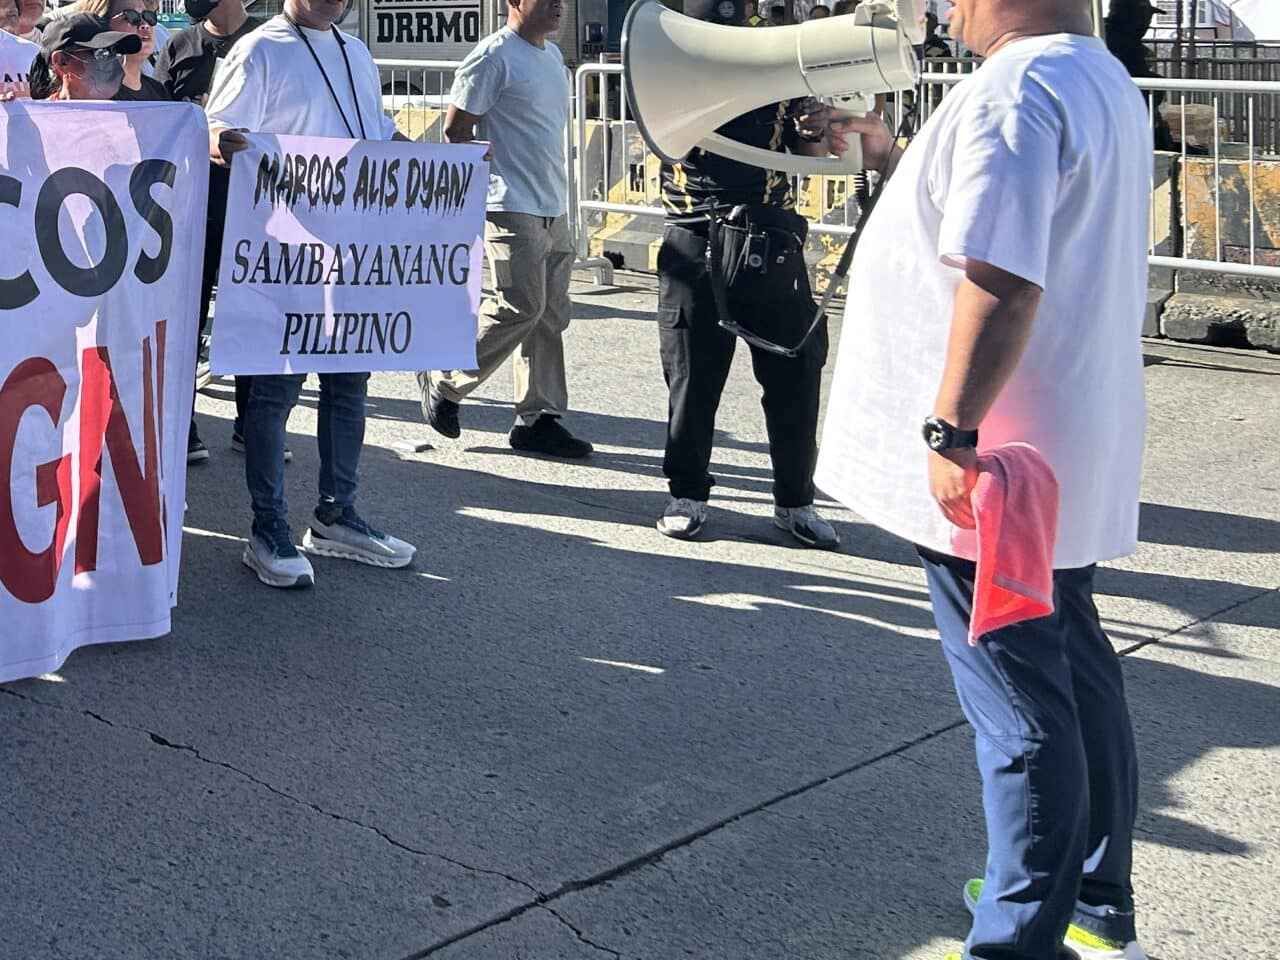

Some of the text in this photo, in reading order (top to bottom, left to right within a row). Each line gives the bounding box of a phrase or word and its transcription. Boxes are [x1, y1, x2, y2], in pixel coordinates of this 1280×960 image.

[377, 11, 479, 43] DRRMO
[253, 152, 473, 216] MARCOS ALIS DYAN!
[232, 239, 470, 286] SAMBAYANANG
[280, 311, 412, 355] PILIPINO
